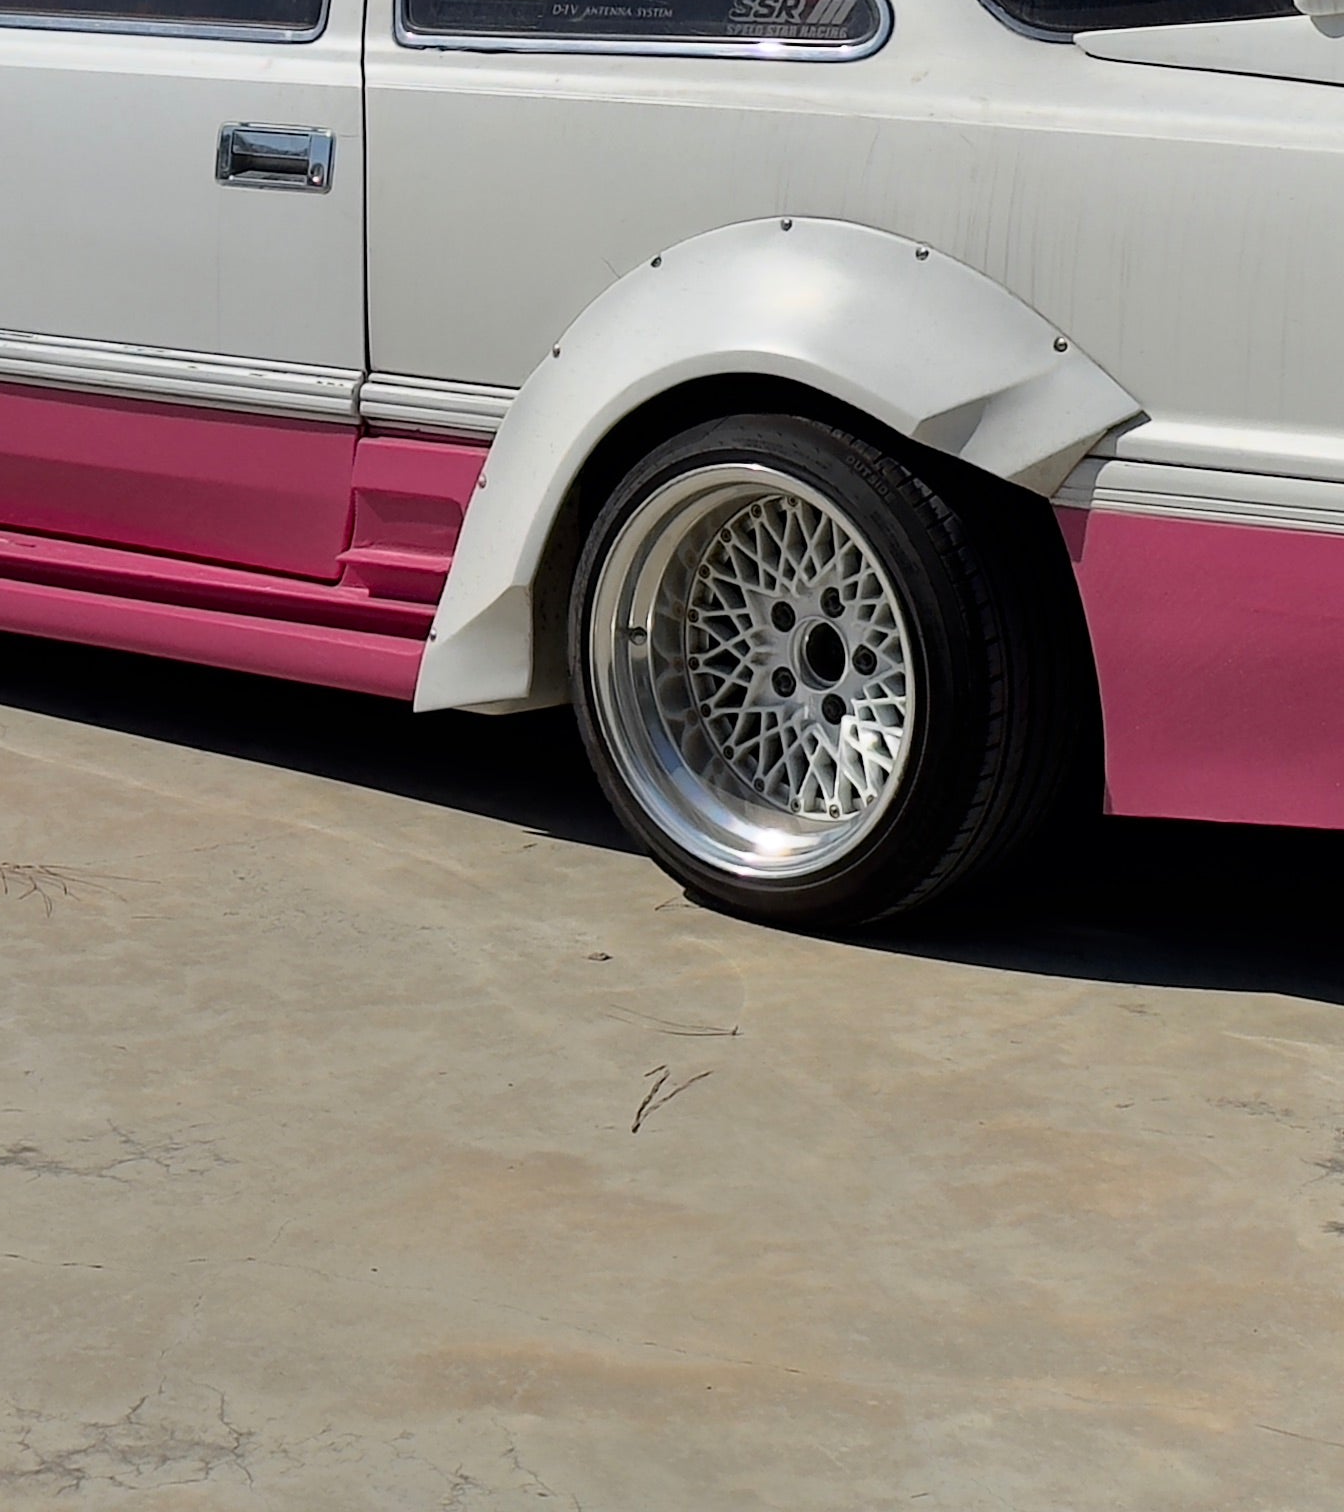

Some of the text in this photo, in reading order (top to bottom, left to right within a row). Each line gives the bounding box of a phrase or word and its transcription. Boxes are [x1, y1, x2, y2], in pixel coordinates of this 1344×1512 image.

[582, 6, 632, 17] ANTENNA
[637, 7, 674, 18] SYSTEM
[726, 24, 849, 39] SPEED STAR RACING
